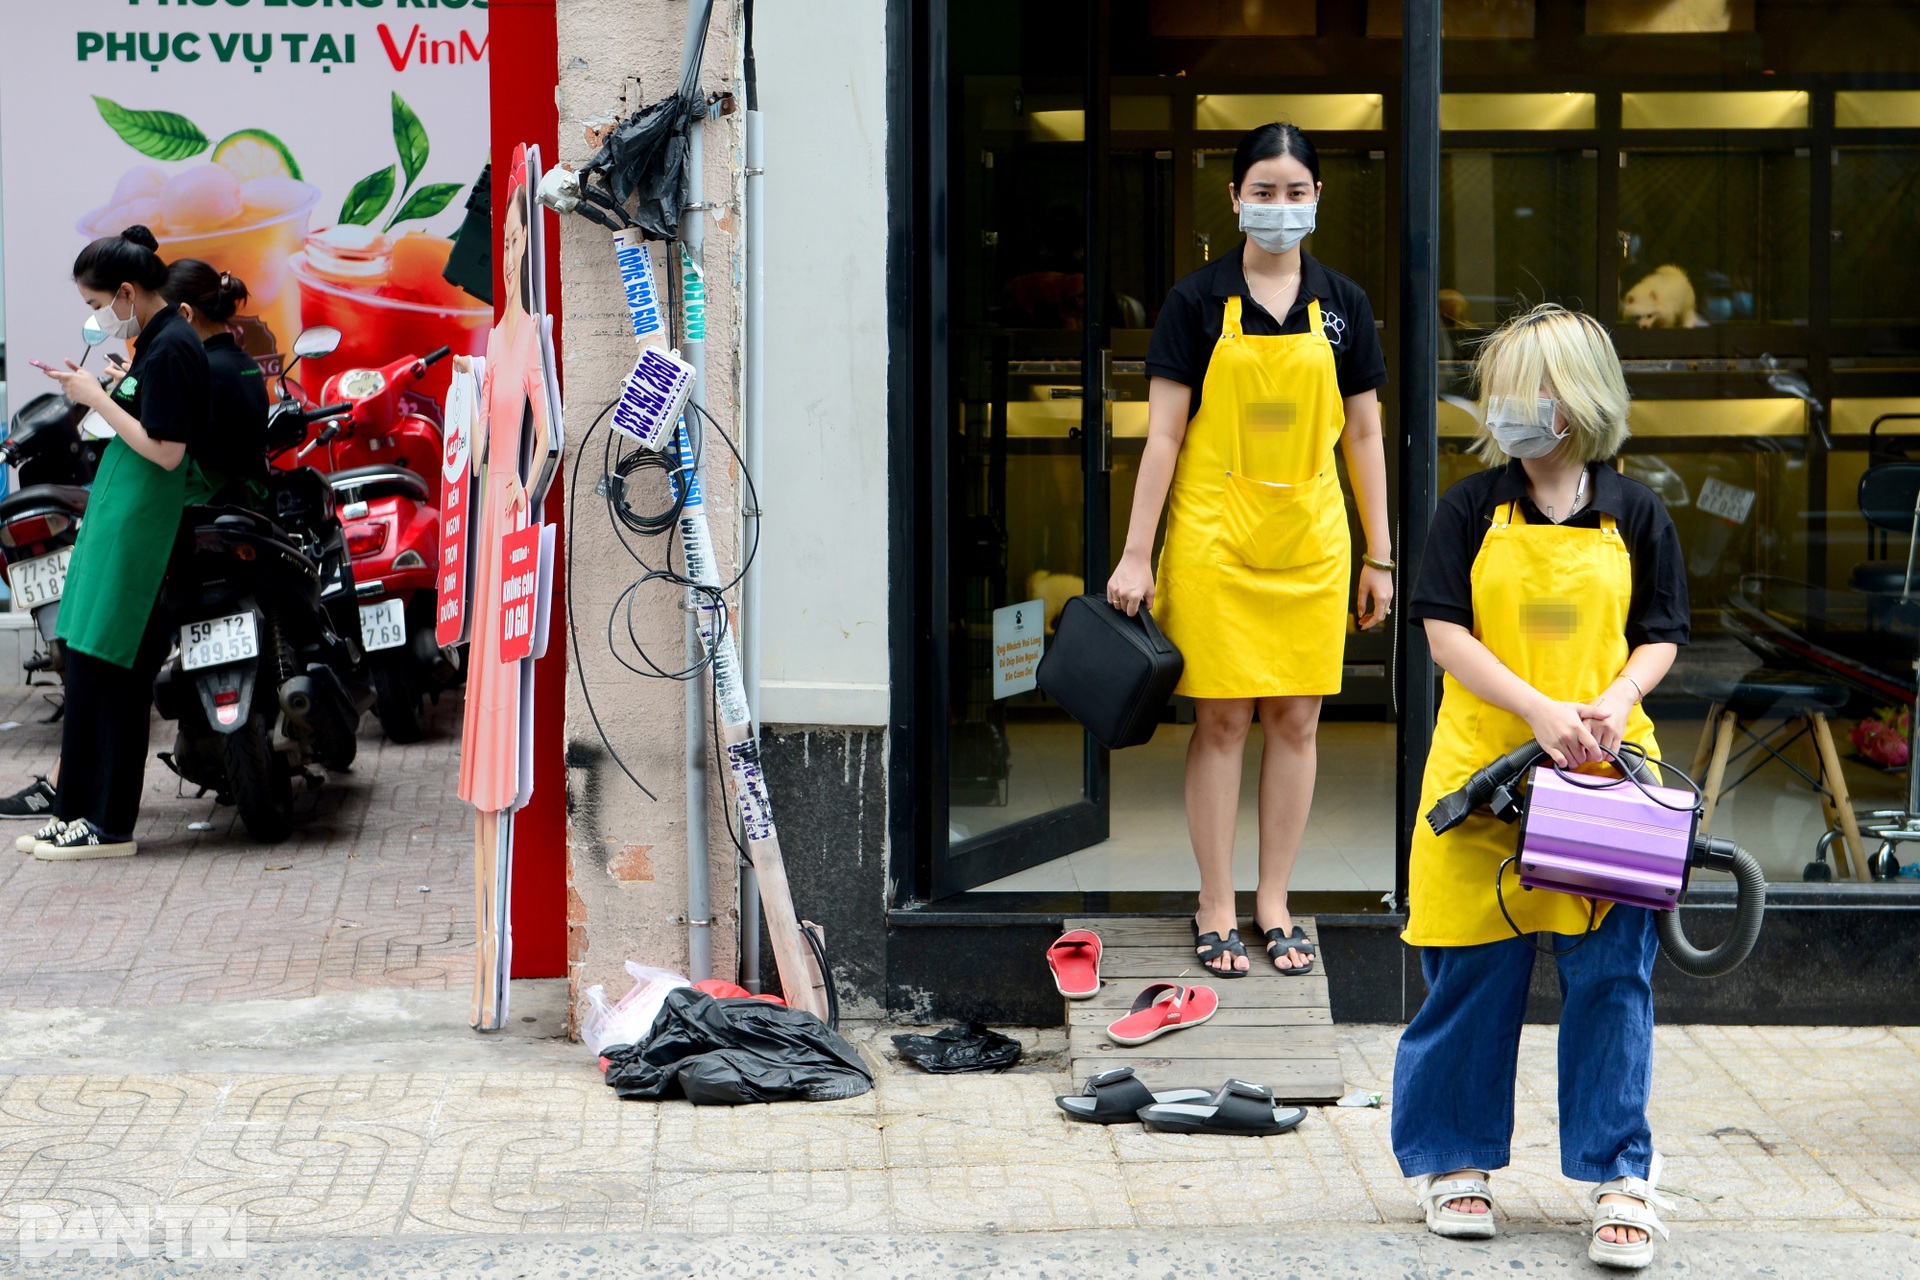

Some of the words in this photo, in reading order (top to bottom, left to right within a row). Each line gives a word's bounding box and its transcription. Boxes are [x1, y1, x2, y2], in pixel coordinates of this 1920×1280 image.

[77, 31, 202, 73] PHỤC
[208, 32, 273, 73] VỤ
[281, 33, 356, 74] TẠI
[24, 575, 67, 603] 518
[190, 616, 245, 644] 59-T2
[504, 607, 515, 641] LO
[515, 597, 529, 638] GIÁ
[188, 636, 252, 665] 489.55
